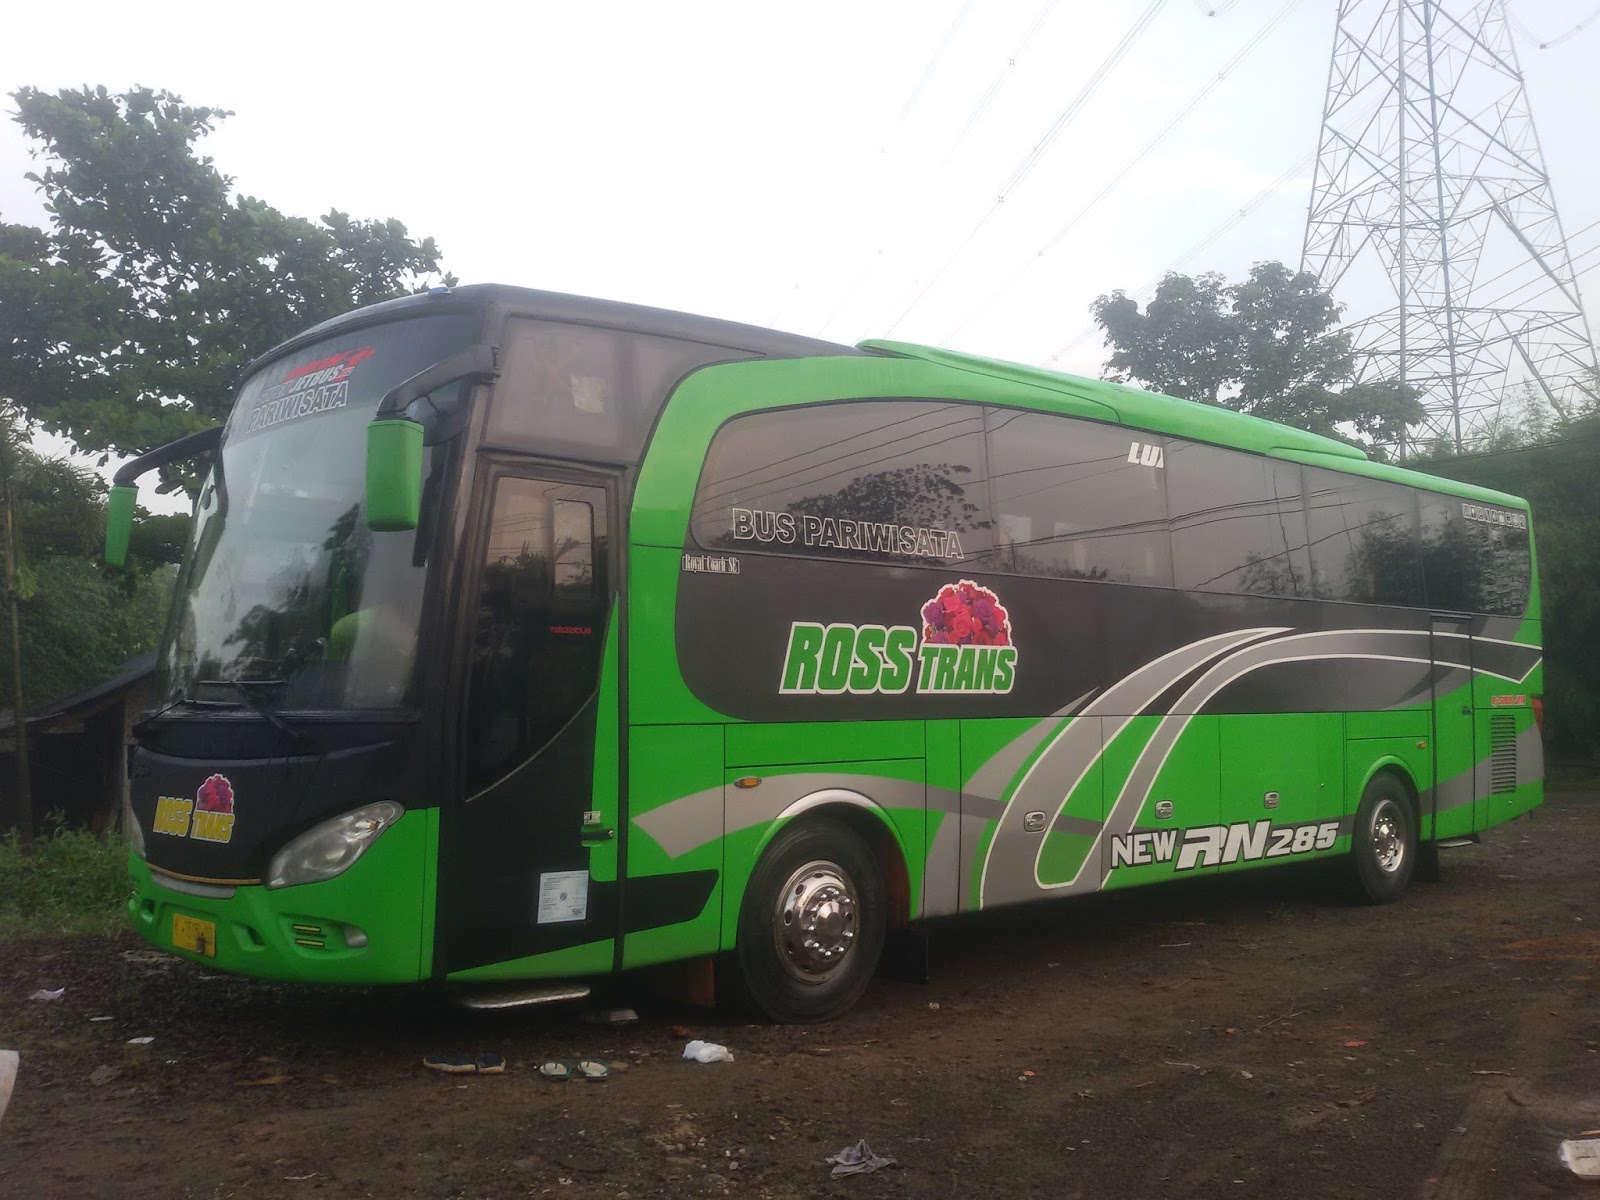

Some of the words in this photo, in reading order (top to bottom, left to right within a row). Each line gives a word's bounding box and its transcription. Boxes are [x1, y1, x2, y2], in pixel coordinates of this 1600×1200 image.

[289, 364, 343, 393] JETBUS
[246, 380, 349, 434] PARIWISATA
[732, 508, 796, 544] BUS
[804, 516, 964, 559] PARIWISATA
[685, 553, 705, 573] Royal
[779, 621, 918, 694] ROSS
[916, 644, 1017, 694] TRANS
[1110, 828, 1179, 869] NEW
[1174, 818, 1272, 872] RN
[1264, 820, 1340, 859] 285
